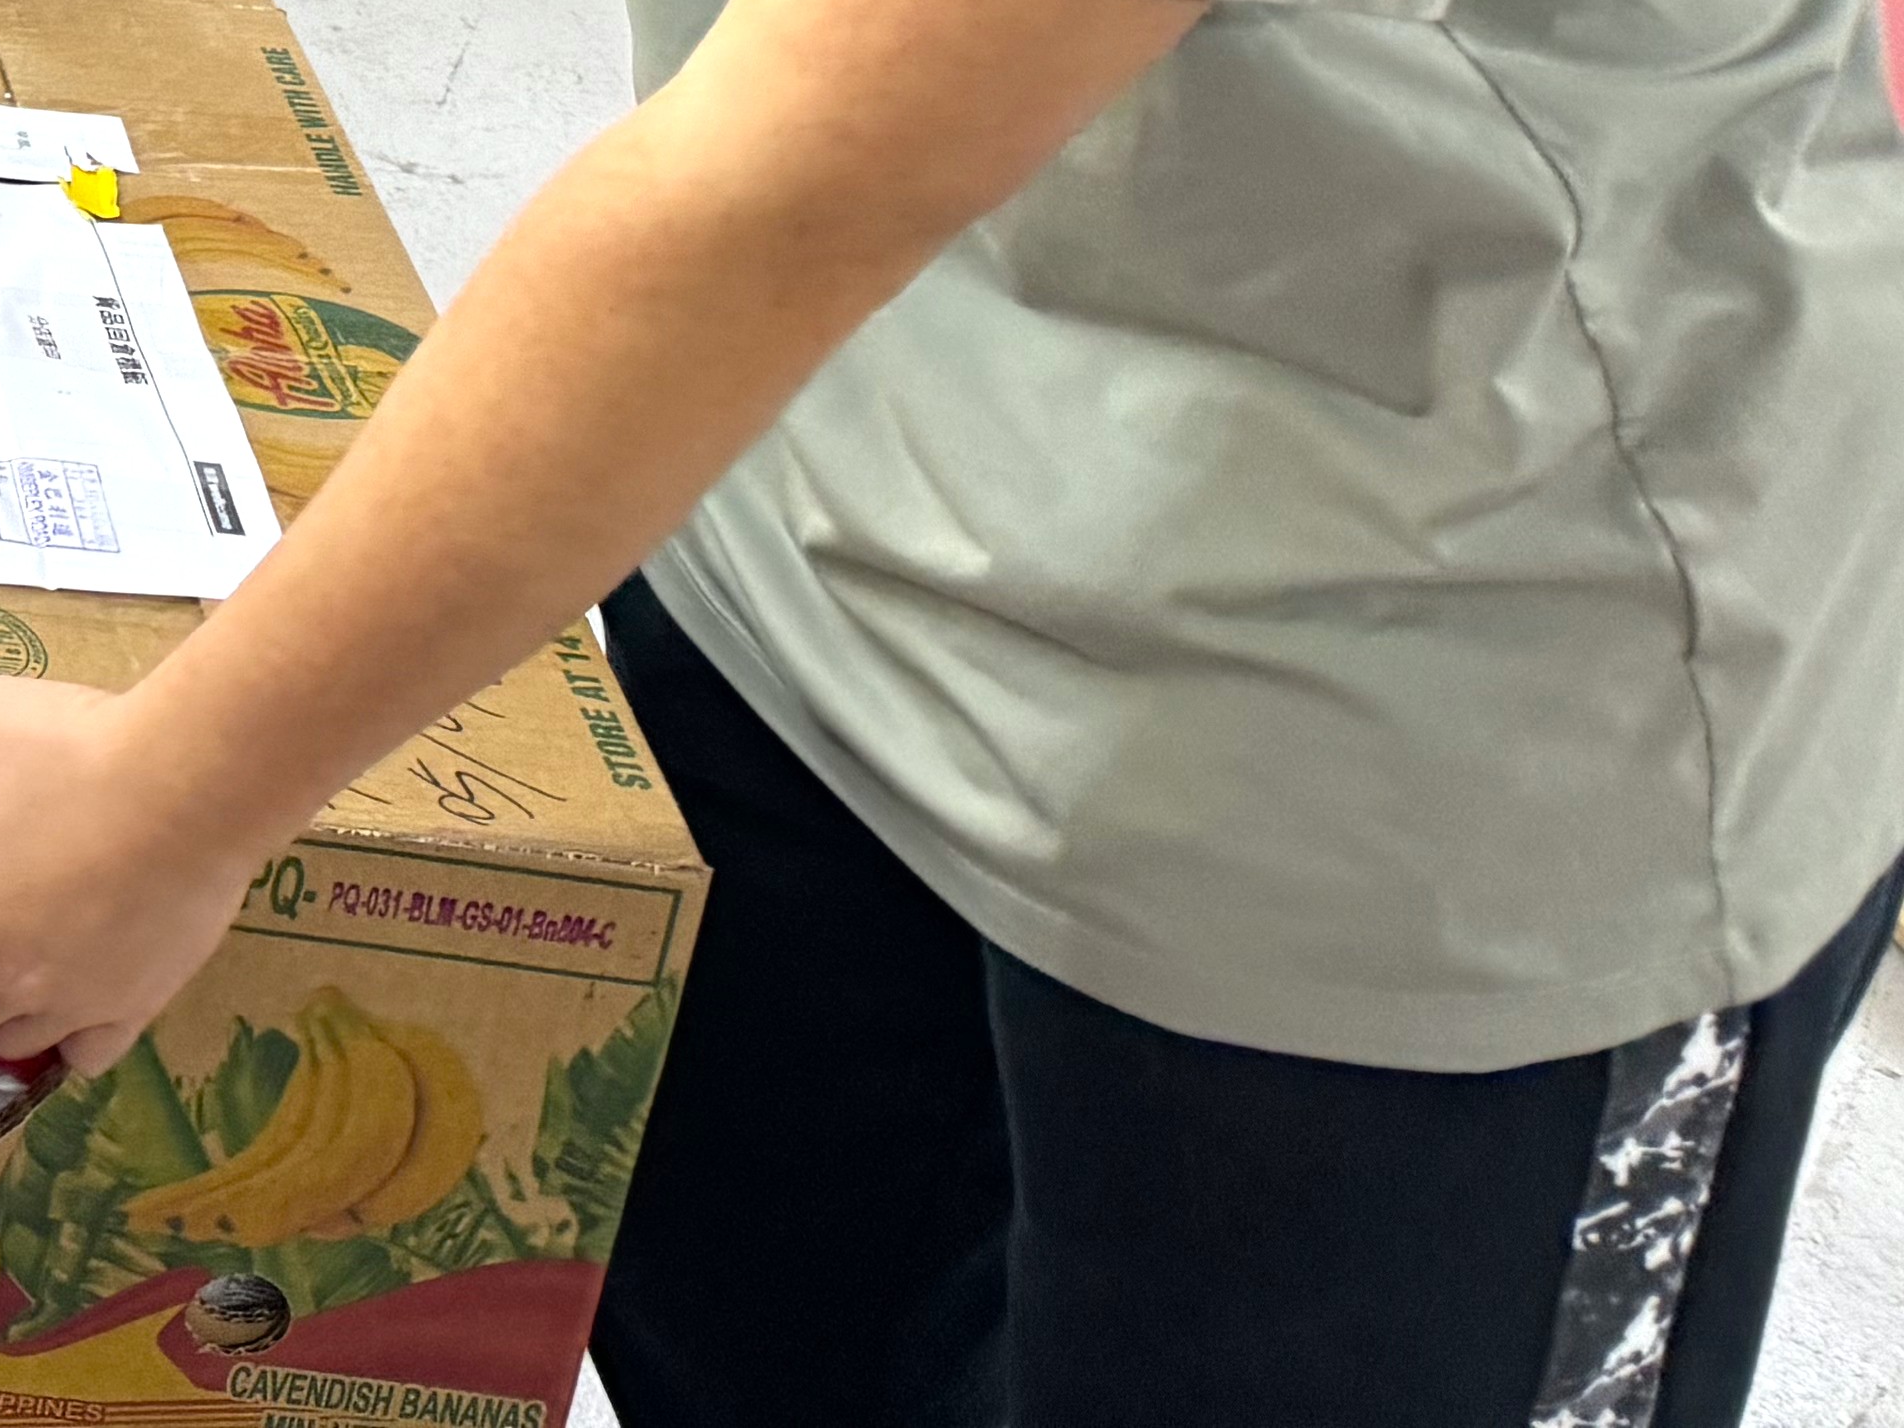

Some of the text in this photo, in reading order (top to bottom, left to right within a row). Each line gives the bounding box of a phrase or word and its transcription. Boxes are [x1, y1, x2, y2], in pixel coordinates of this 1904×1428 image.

[260, 46, 361, 197] HANDLE WITH CARE
[219, 298, 339, 409] Aloha
[562, 667, 612, 704] AT
[579, 706, 654, 792] STORE
[228, 1364, 546, 1428] CAVENDISH BANANAS
